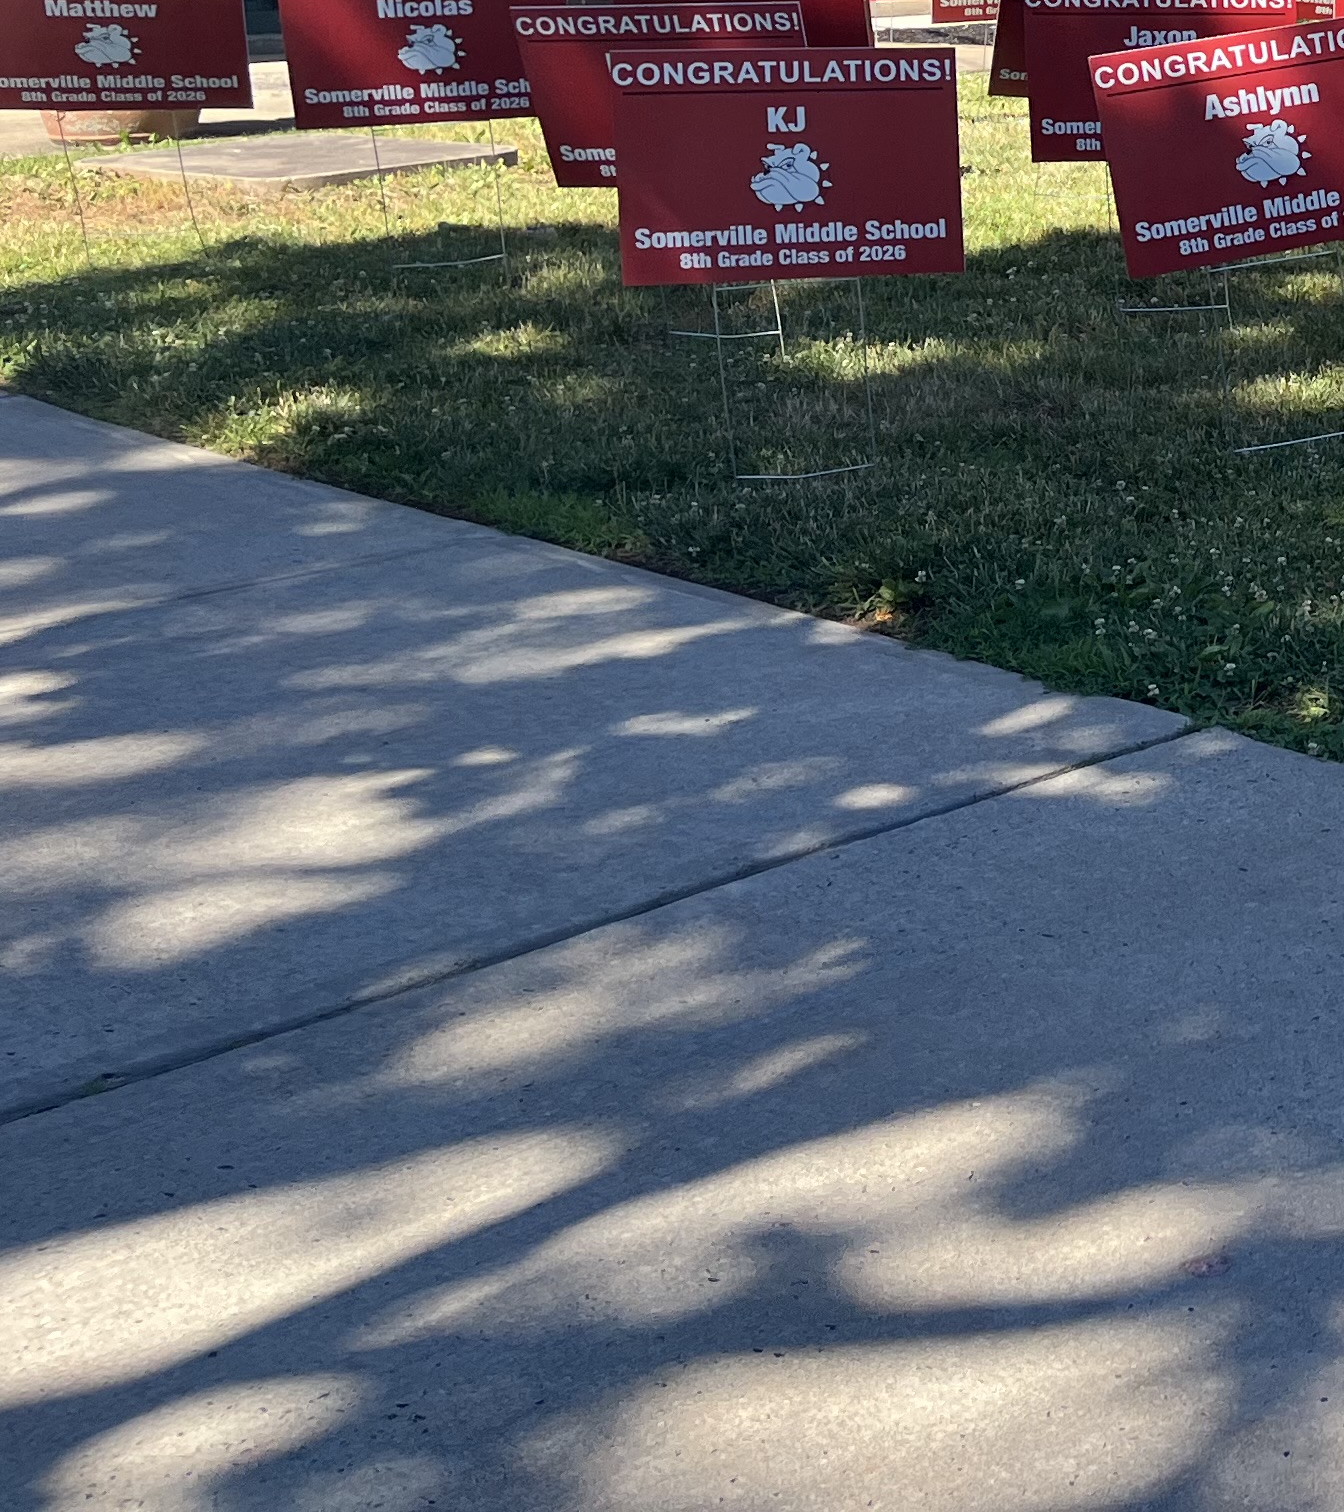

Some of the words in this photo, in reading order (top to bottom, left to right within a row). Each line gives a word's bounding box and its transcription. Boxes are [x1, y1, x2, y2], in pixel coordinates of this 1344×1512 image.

[44, 0, 157, 17] Matthew
[516, 13, 799, 35] CONGRATULATIONS!
[1124, 26, 1199, 48] Jaxon
[0, 75, 90, 88] omerville
[97, 75, 165, 88] Middle
[171, 75, 238, 88] School
[612, 59, 951, 85] CONGRATULATIONS!
[21, 92, 47, 101] 8th
[51, 91, 96, 101] Grade
[101, 91, 142, 101] Class
[147, 91, 162, 101] of
[167, 91, 206, 101] 2026
[305, 85, 414, 103] Somerville
[420, 81, 489, 98] Middle
[1205, 83, 1319, 120] Ashlynn
[343, 105, 369, 117] 8th
[374, 103, 420, 115] Grade
[424, 101, 466, 113] Class
[471, 98, 486, 110] of
[491, 97, 529, 109] 2026
[767, 106, 805, 132] KJ
[1136, 205, 1257, 244] Somerville
[1263, 189, 1340, 225] Middle
[635, 225, 767, 249] Somerville
[775, 222, 857, 243] Middle
[865, 219, 946, 240] School
[1179, 237, 1209, 255] 8th
[1214, 228, 1265, 248] Grade
[1270, 219, 1316, 238] Class
[1321, 212, 1338, 228] of
[680, 253, 711, 269] 8th
[718, 250, 773, 267] Grade
[779, 249, 829, 264] Class
[835, 246, 853, 262] of
[859, 245, 906, 261] 2026
